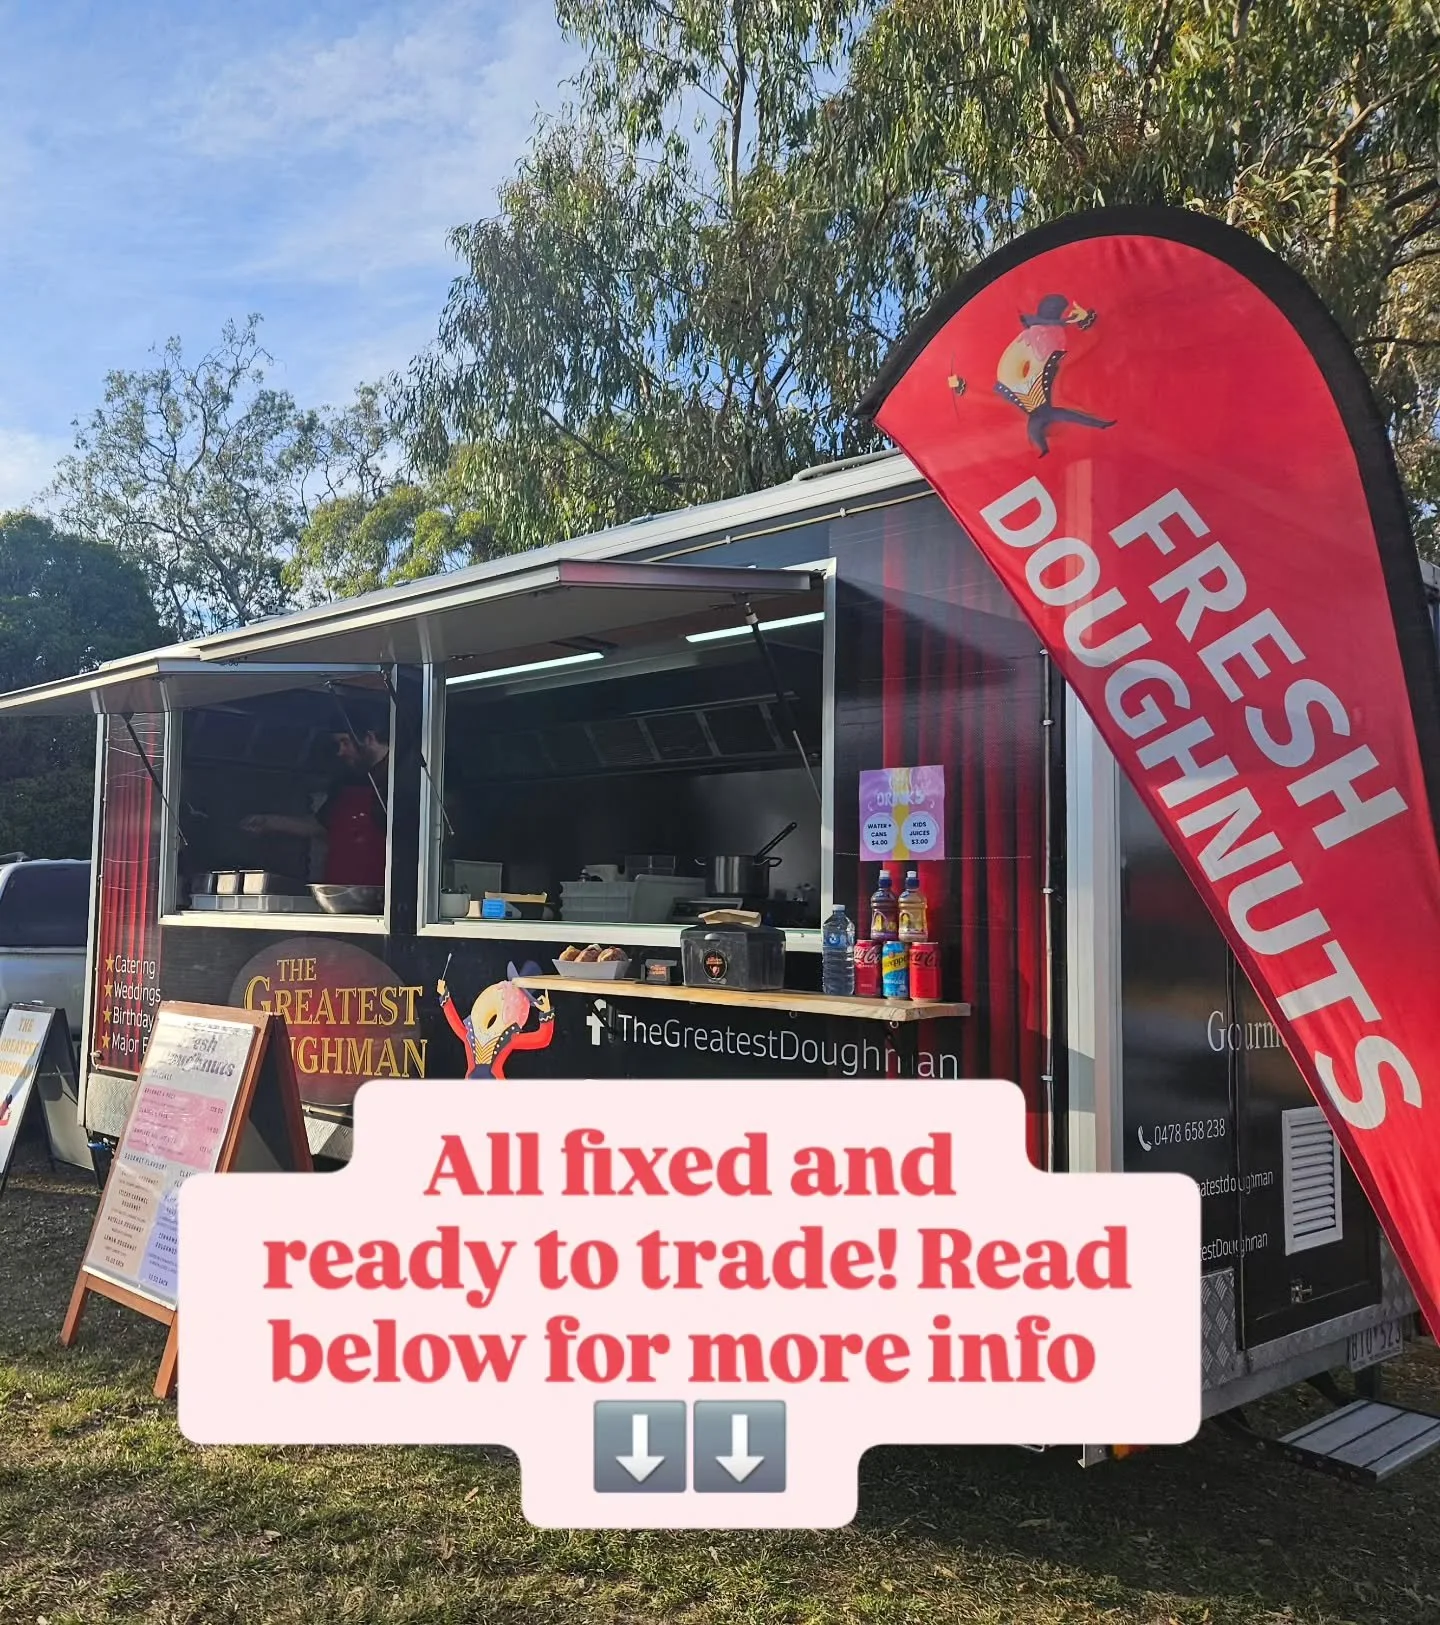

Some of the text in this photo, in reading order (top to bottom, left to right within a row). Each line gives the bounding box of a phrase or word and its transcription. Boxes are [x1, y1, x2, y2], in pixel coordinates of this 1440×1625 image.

[1110, 488, 1408, 849] FRESH
[980, 477, 1422, 1129] DOUGHNUTS
[115, 954, 156, 979] Catering
[277, 957, 317, 982] THE
[113, 980, 161, 1006] Weddings
[243, 975, 423, 1026] GREATEST
[112, 1006, 155, 1033] Birthday
[1207, 1010, 1288, 1052] Gourm
[111, 1031, 140, 1056] Major
[290, 1036, 428, 1079] GHMAN
[1154, 1118, 1226, 1146] 0478 658 238
[1200, 1232, 1268, 1262] estDoughman
